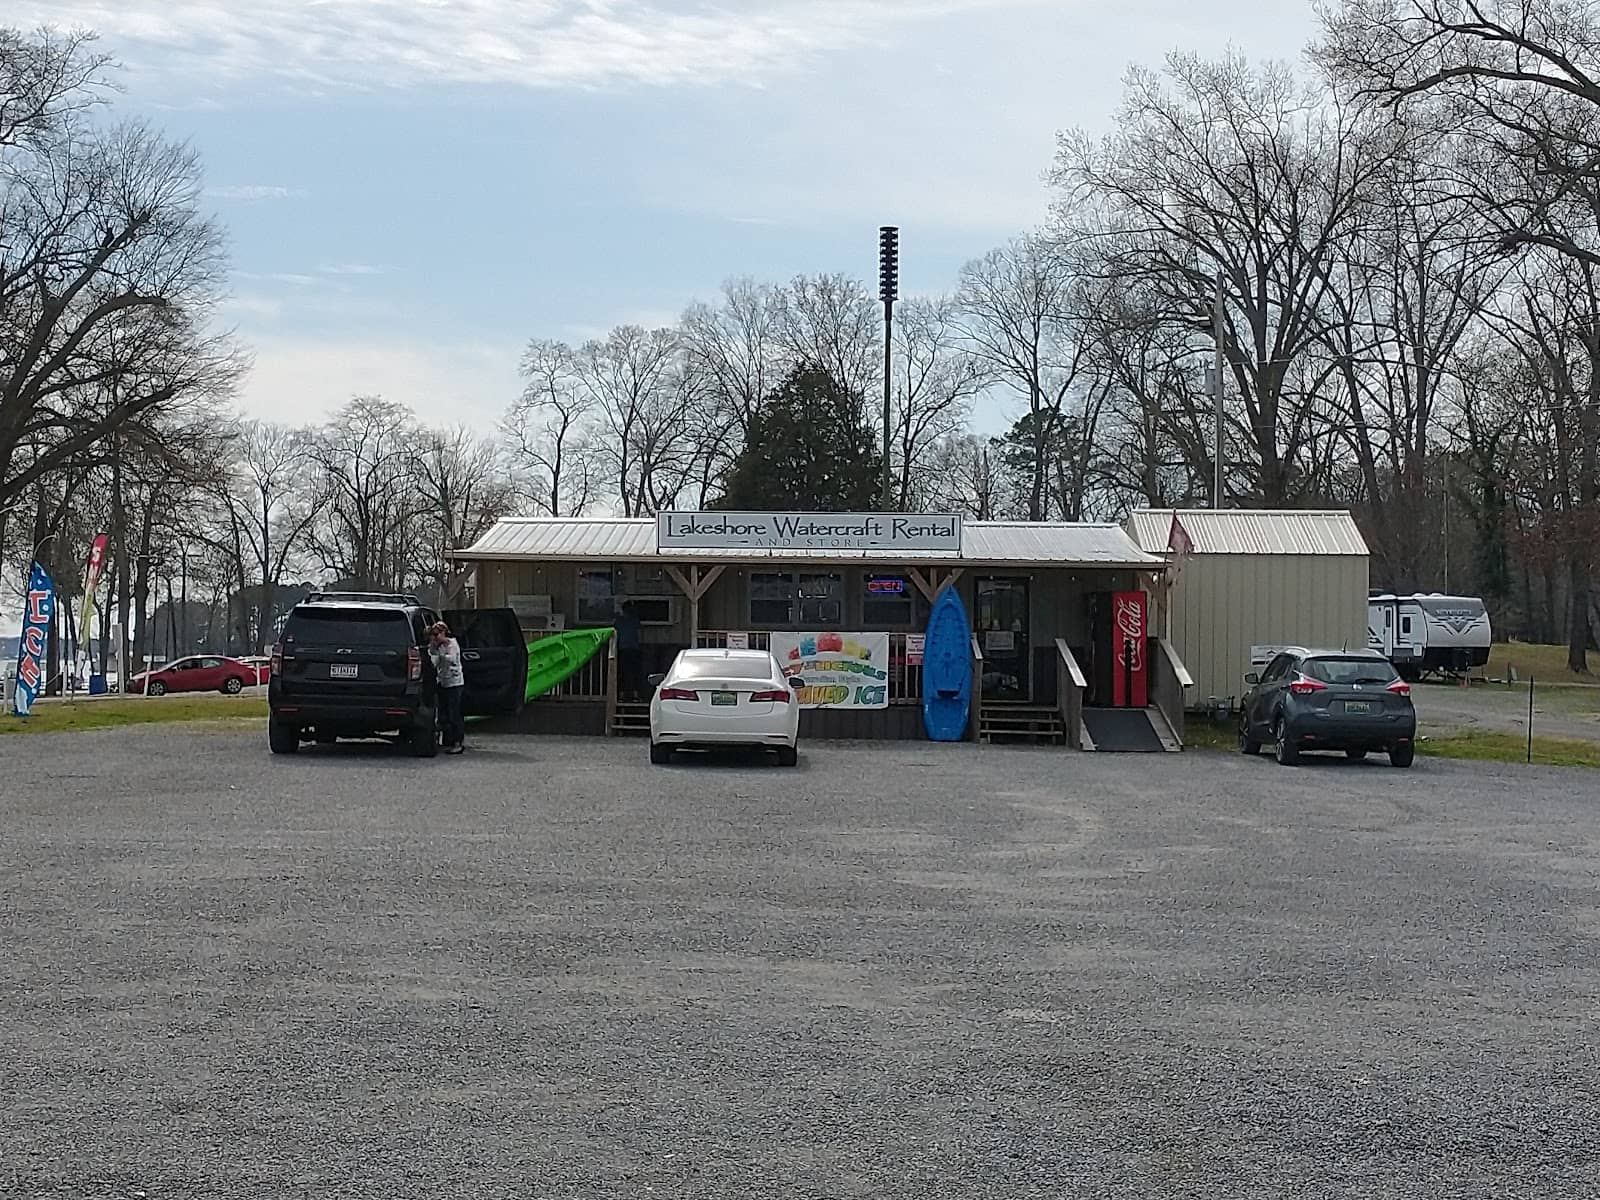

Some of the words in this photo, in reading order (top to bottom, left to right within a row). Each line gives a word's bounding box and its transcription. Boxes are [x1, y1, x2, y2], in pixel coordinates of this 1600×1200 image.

[666, 515, 767, 537] Lakeshore
[773, 517, 883, 538] Watercraft
[892, 517, 955, 539] Rental
[755, 538, 791, 547] AND
[806, 538, 863, 547] STORE
[867, 581, 901, 592] OPEN
[20, 589, 51, 689] ICE
[795, 685, 849, 704] AVED
[853, 685, 887, 704] ICE
